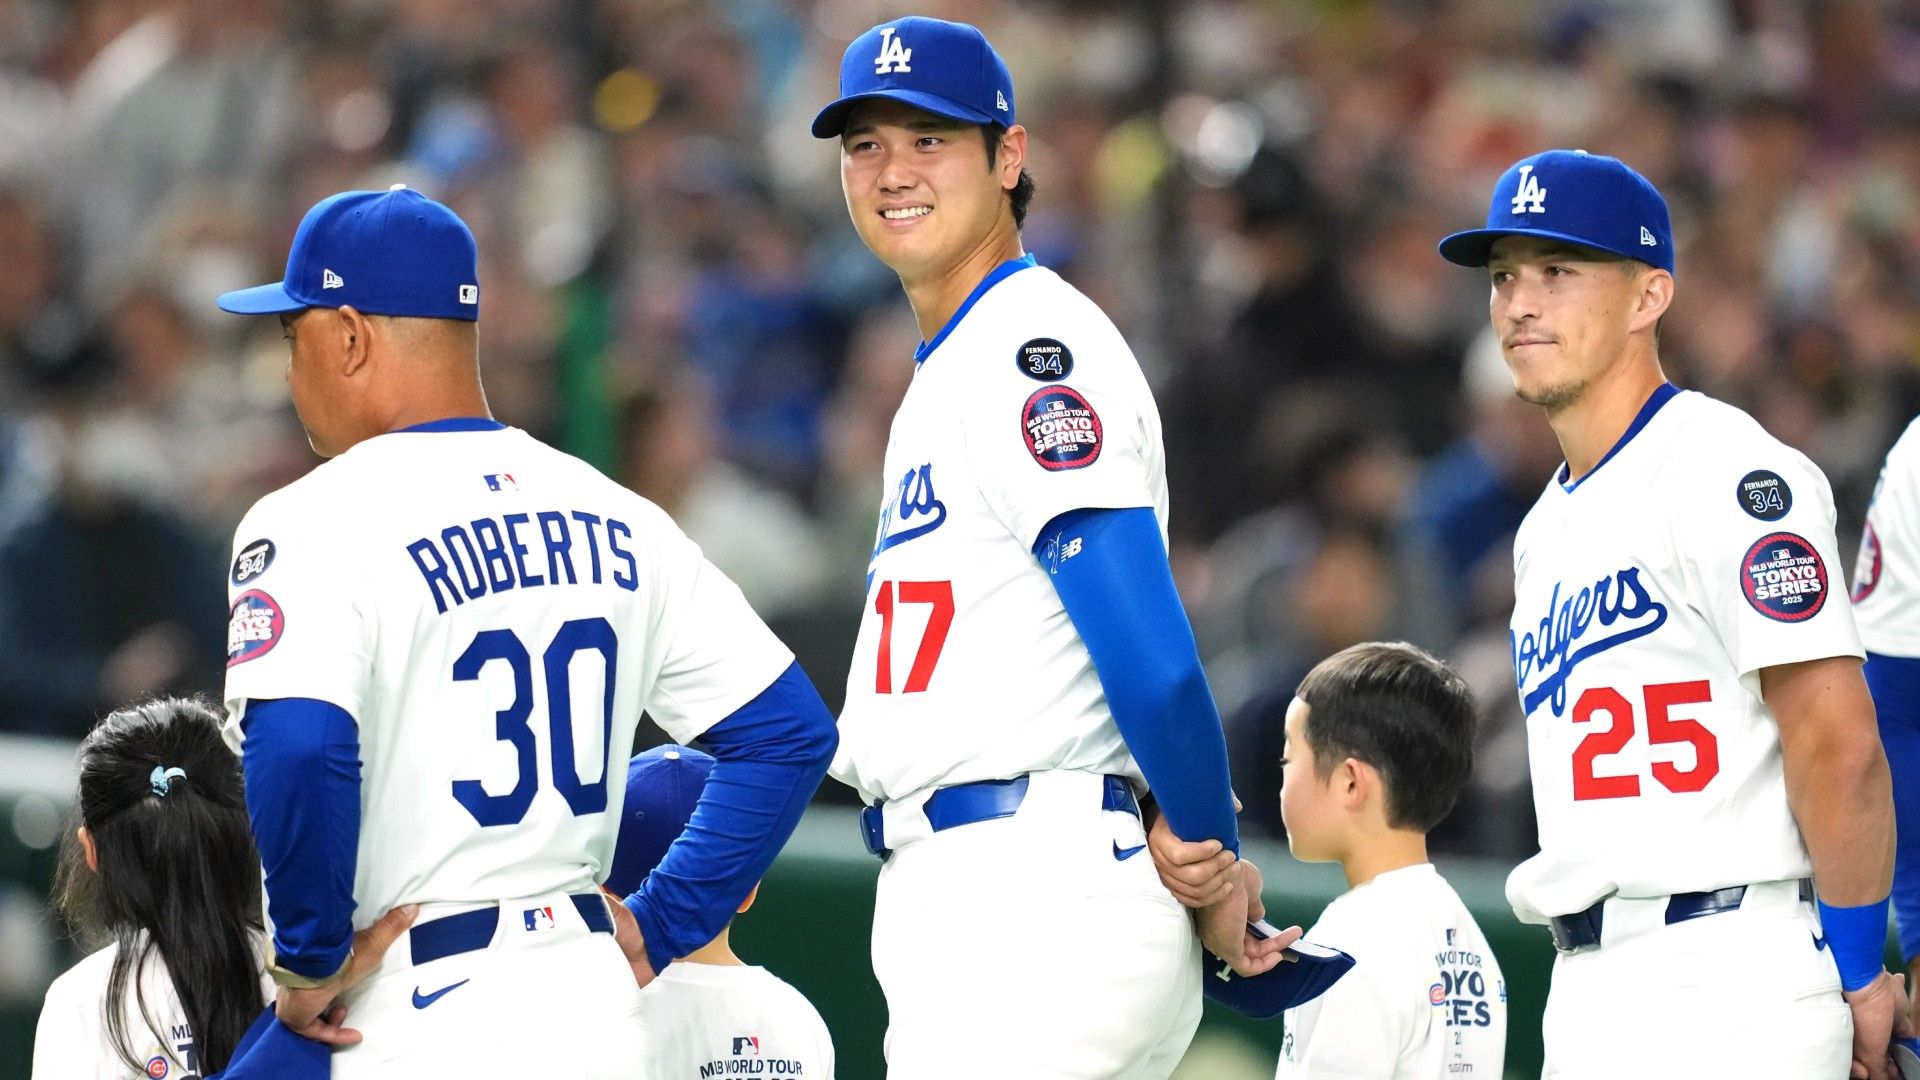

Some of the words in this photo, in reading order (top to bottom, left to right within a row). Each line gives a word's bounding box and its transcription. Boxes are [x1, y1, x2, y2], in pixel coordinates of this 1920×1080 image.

[874, 27, 912, 75] LA
[1511, 165, 1547, 215] LA
[1025, 346, 1062, 355] FERNANDO
[1028, 354, 1063, 375] 34
[1026, 415, 1042, 430] MLB
[1040, 409, 1071, 421] WORLD
[1071, 409, 1091, 417] TOUR
[1030, 417, 1092, 440] TOKYO
[1034, 430, 1097, 455] SERIES
[1057, 444, 1079, 454] 2025
[1744, 479, 1779, 491] FERNANDO
[1749, 487, 1784, 513] 34
[237, 551, 266, 581] 34
[406, 510, 639, 615] ROBERTS
[1749, 562, 1768, 574] MLB
[1766, 558, 1795, 570] WORLD
[1795, 556, 1816, 565] TOUR
[1753, 565, 1817, 586] TOKYO
[1755, 578, 1822, 600] SERIES
[1782, 595, 1803, 605] 2025
[875, 580, 955, 694] 17
[452, 616, 619, 827] 30
[1572, 679, 1719, 801] 25
[171, 1023, 193, 1040] ML
[724, 1059, 764, 1075] WORLD
[766, 1059, 803, 1076] TOUR
